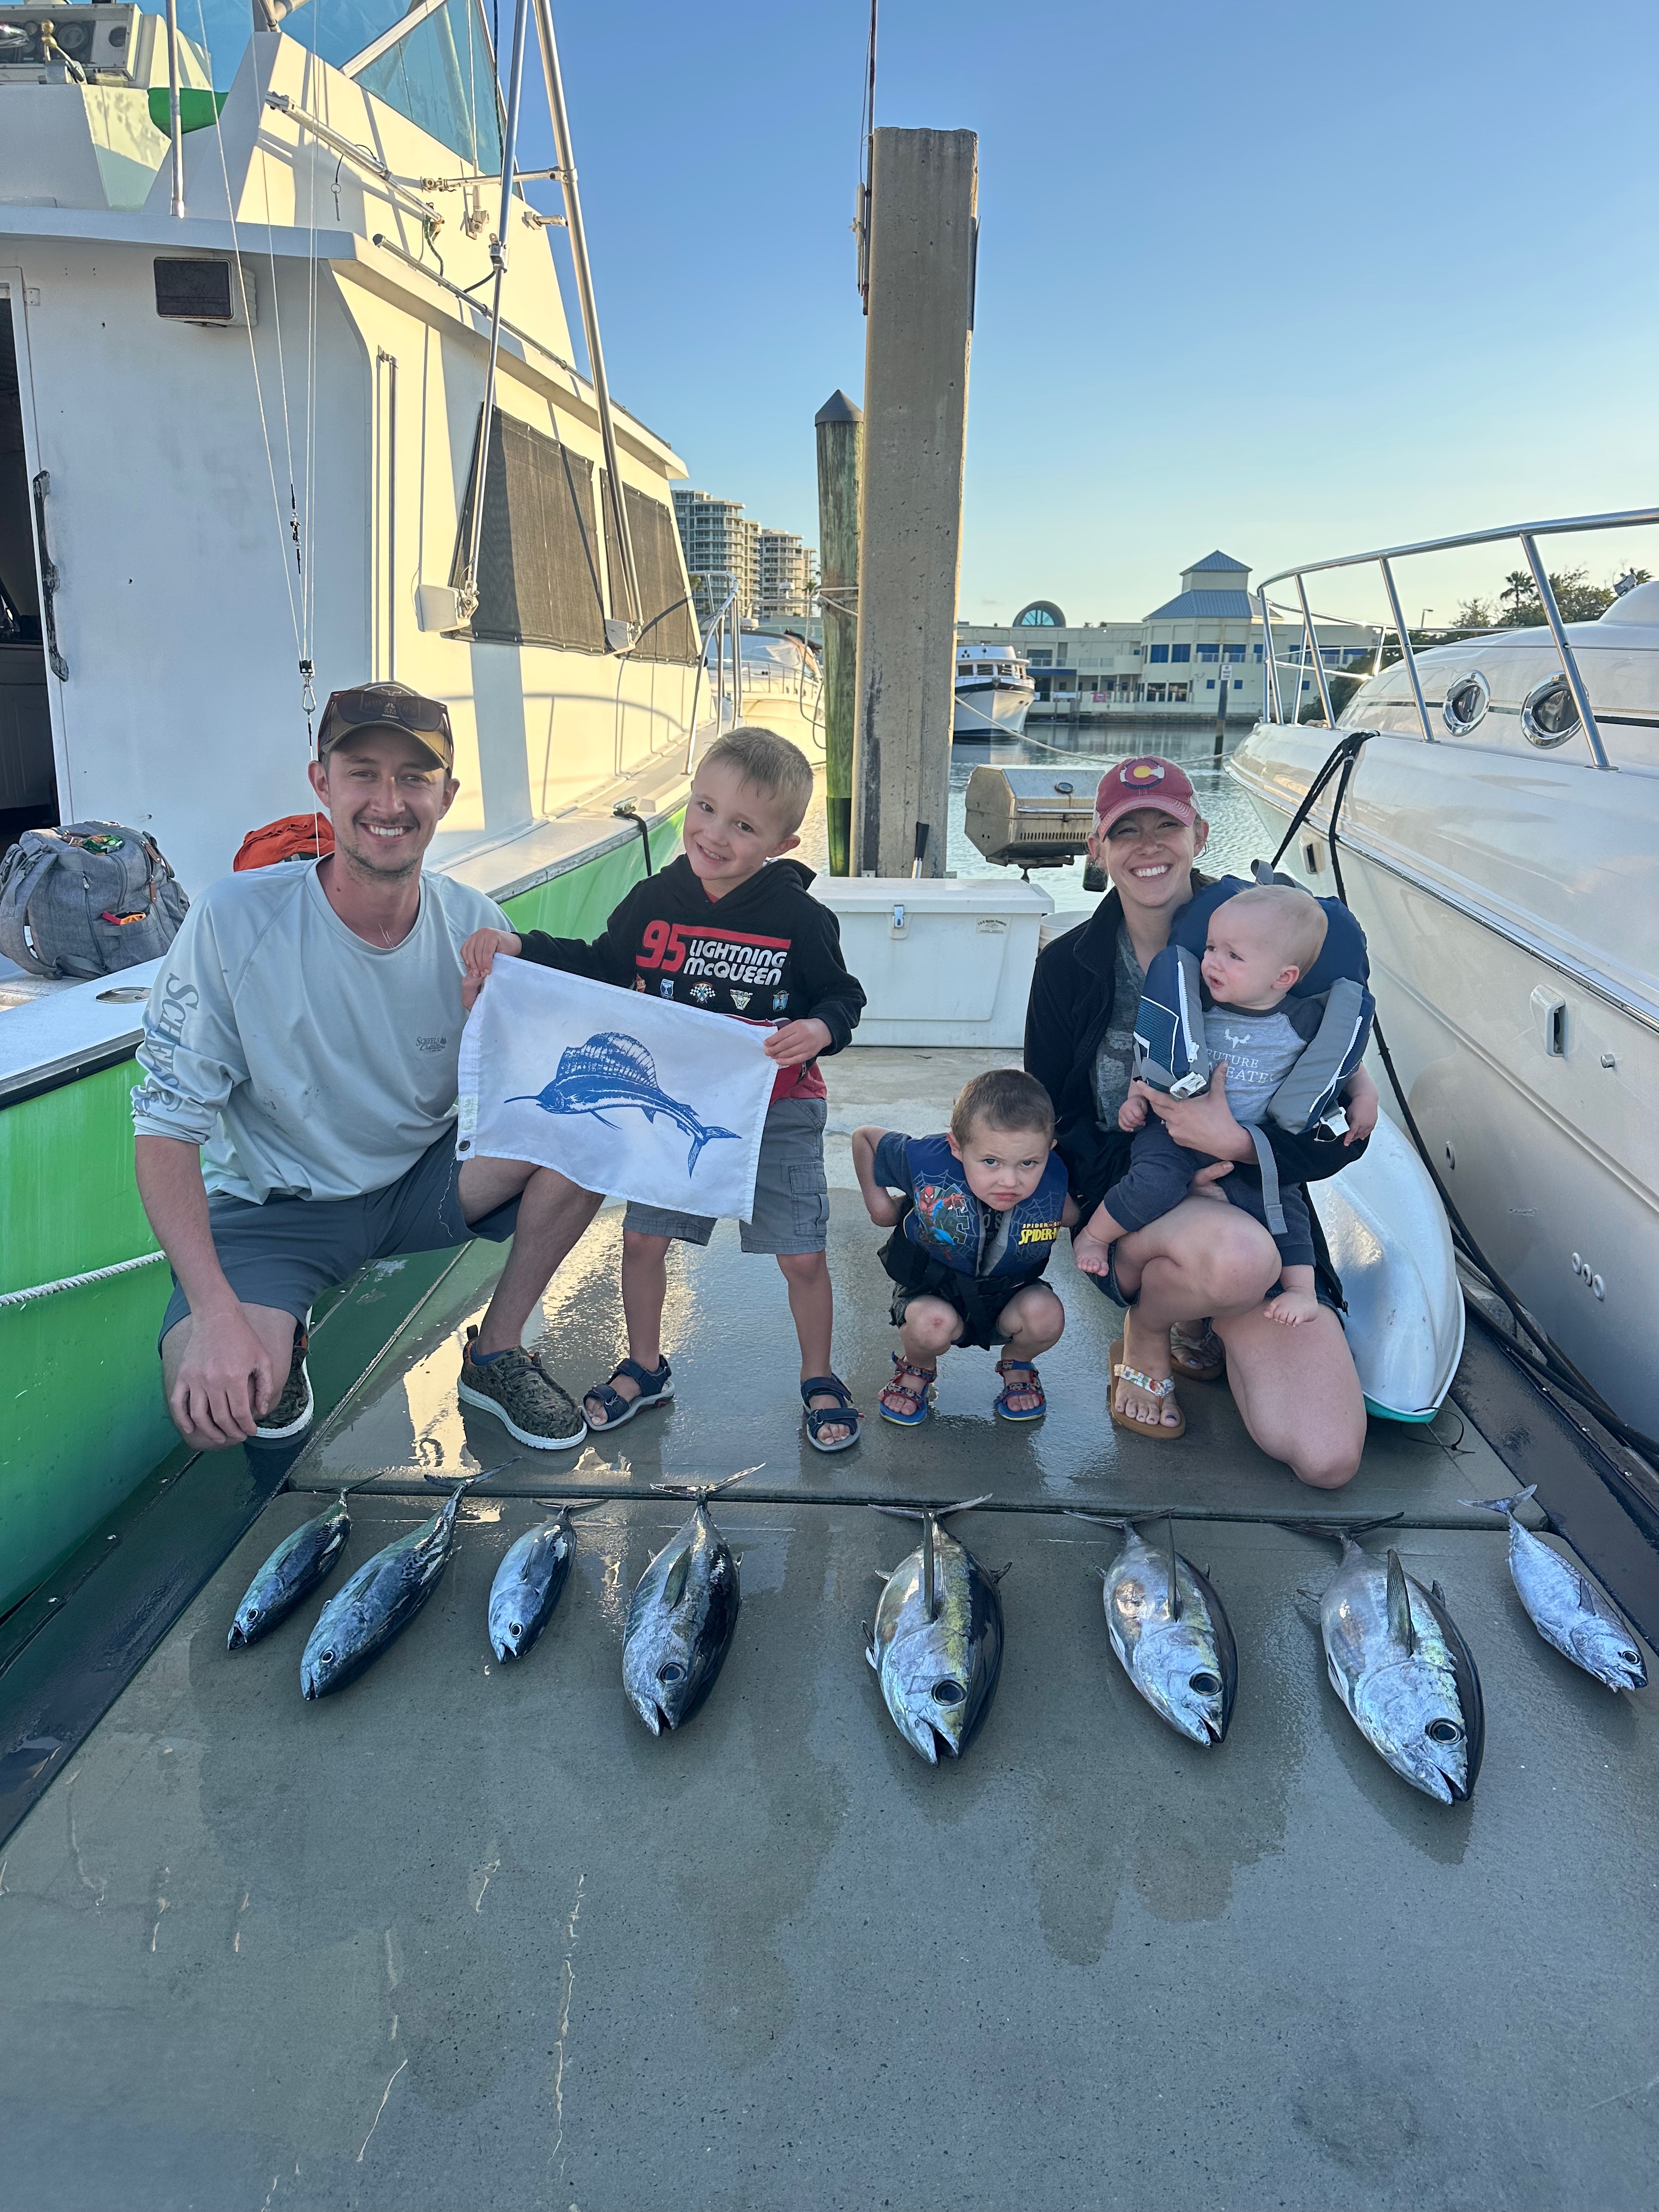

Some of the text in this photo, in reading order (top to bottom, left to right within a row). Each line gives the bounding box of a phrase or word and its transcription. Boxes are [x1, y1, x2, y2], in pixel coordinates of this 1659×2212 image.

[635, 920, 686, 972] 95
[689, 939, 788, 968] LIGHTNING
[416, 1036, 440, 1046] SCHEELS
